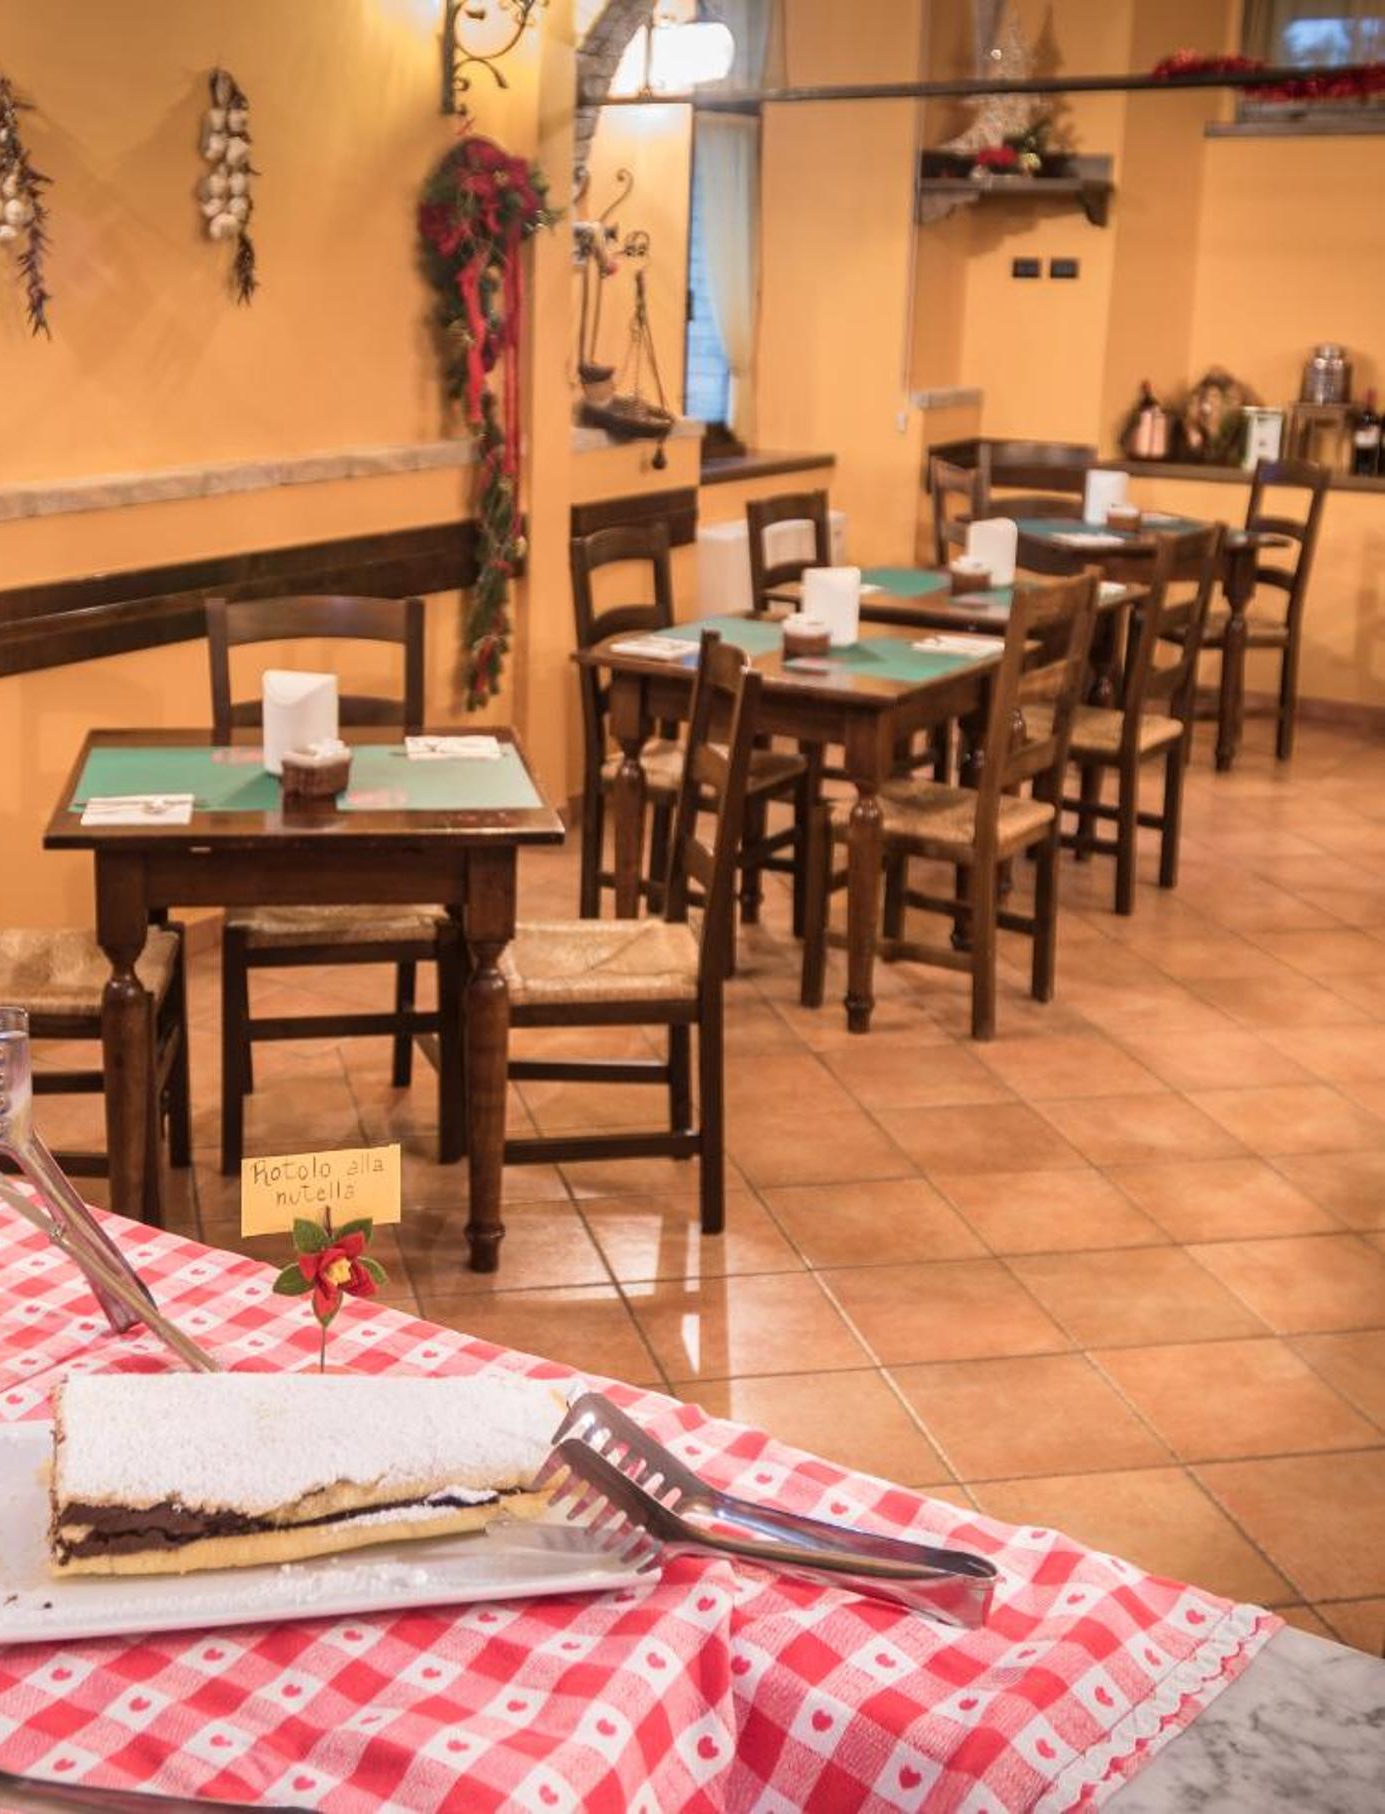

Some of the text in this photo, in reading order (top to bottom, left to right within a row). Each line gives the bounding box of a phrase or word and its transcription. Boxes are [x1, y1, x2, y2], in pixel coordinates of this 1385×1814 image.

[251, 1151, 385, 1187] Rotolo alla
[276, 1181, 356, 1207] nutella
